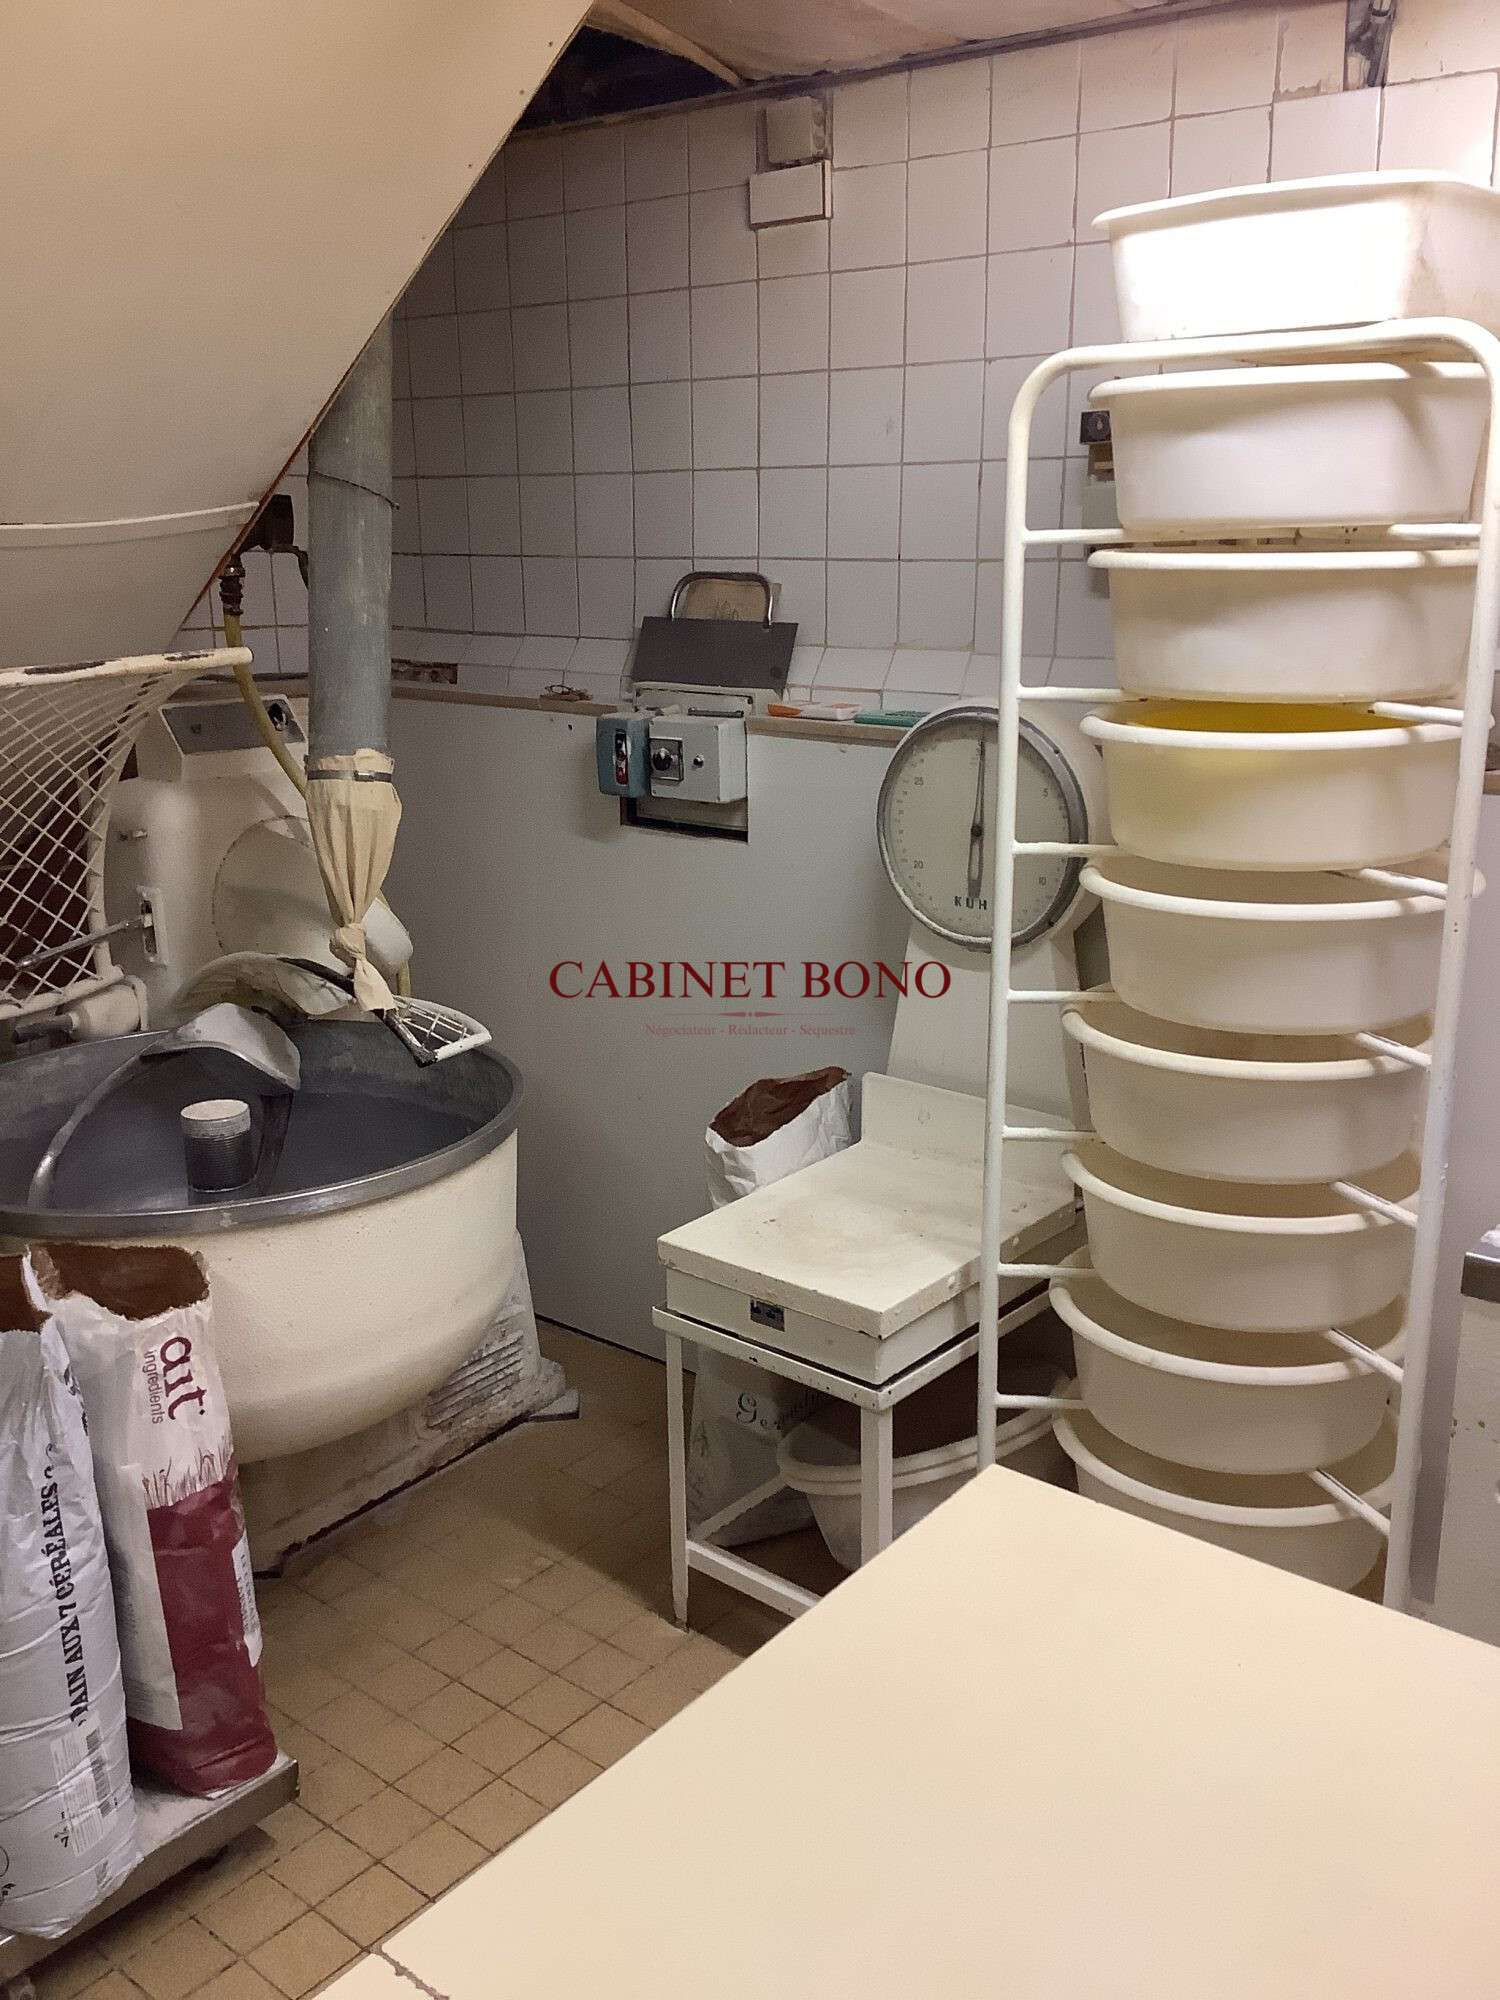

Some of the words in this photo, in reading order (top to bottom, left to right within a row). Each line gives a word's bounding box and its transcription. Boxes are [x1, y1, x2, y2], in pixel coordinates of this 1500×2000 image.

[913, 777, 924, 786] 25
[913, 860, 924, 869] 20
[142, 1349, 165, 1424] ingredients
[41, 1482, 75, 1600] CÉRÉALES
[58, 1601, 77, 1620] 7
[60, 1615, 84, 1664] AUX
